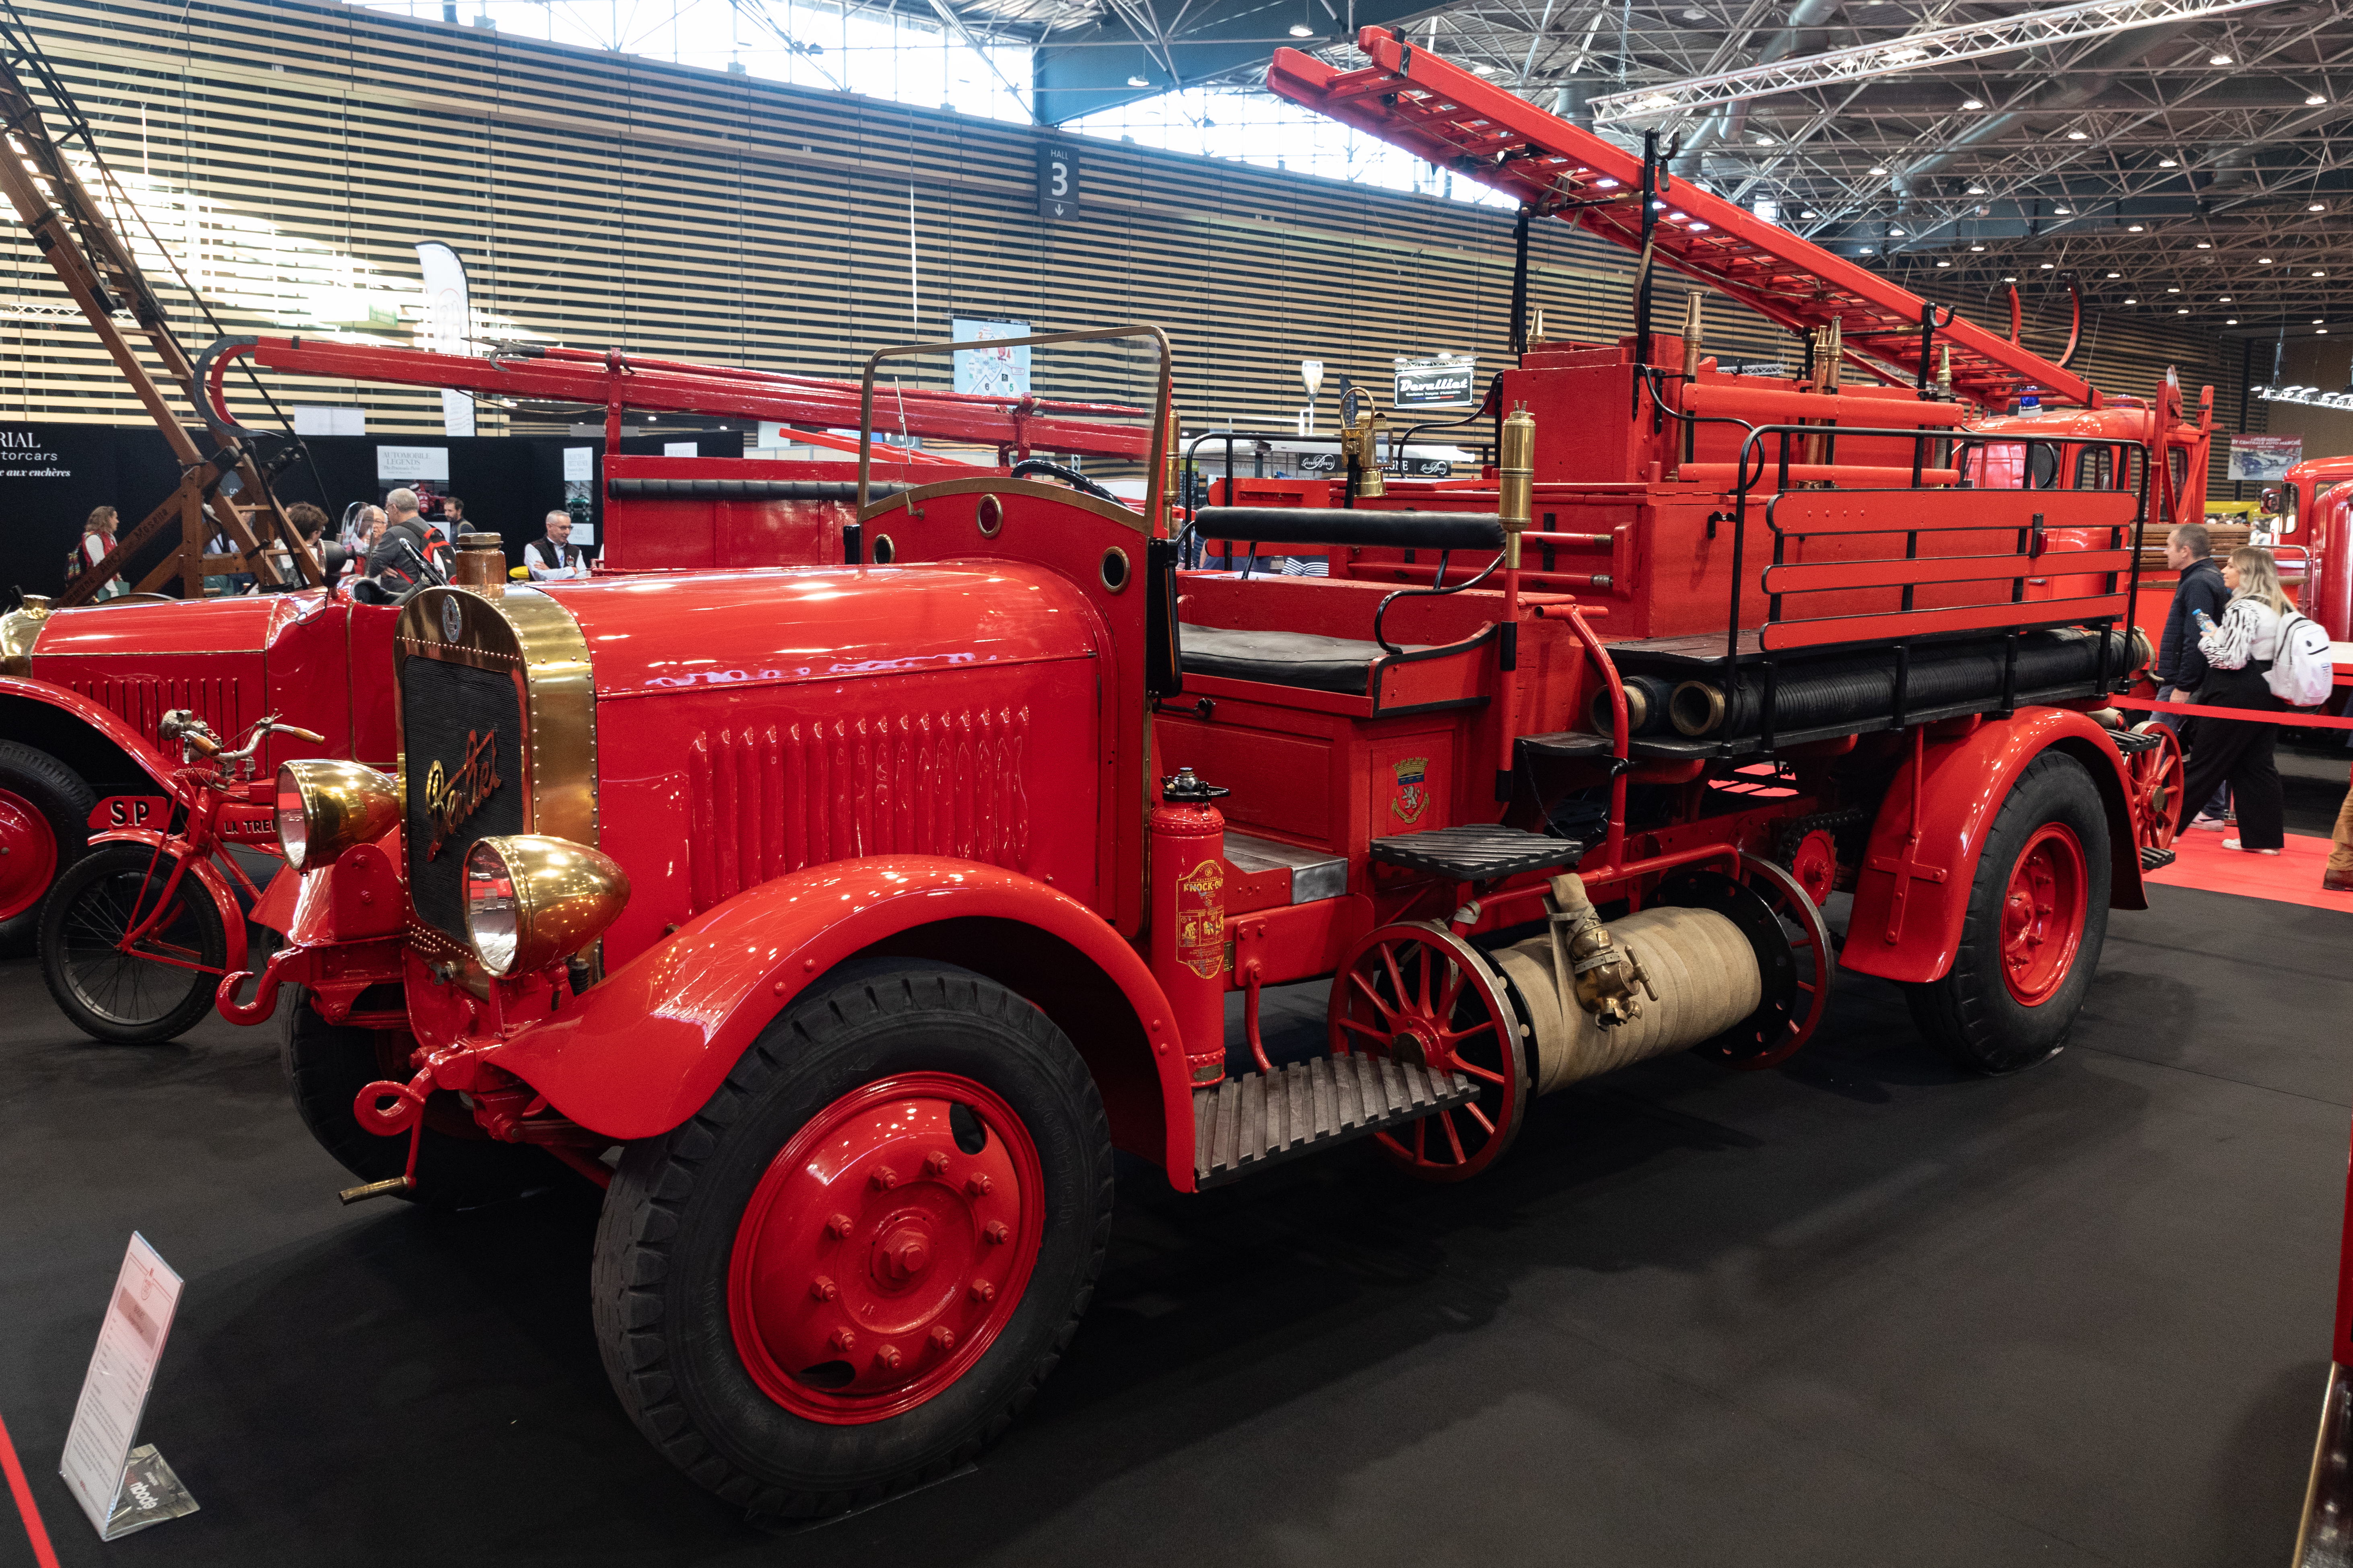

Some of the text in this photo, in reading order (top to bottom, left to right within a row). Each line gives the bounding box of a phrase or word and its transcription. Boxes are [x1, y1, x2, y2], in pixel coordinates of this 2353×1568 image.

[1051, 149, 1069, 160] HALL
[1052, 162, 1067, 196] 3
[1010, 383, 1014, 391] 5
[383, 451, 431, 459] AUTOMOBILE
[29, 467, 71, 477] enchères
[426, 729, 501, 862] Berliet
[224, 821, 239, 834] LA
[1183, 878, 1223, 892] KNOCK-OUT
